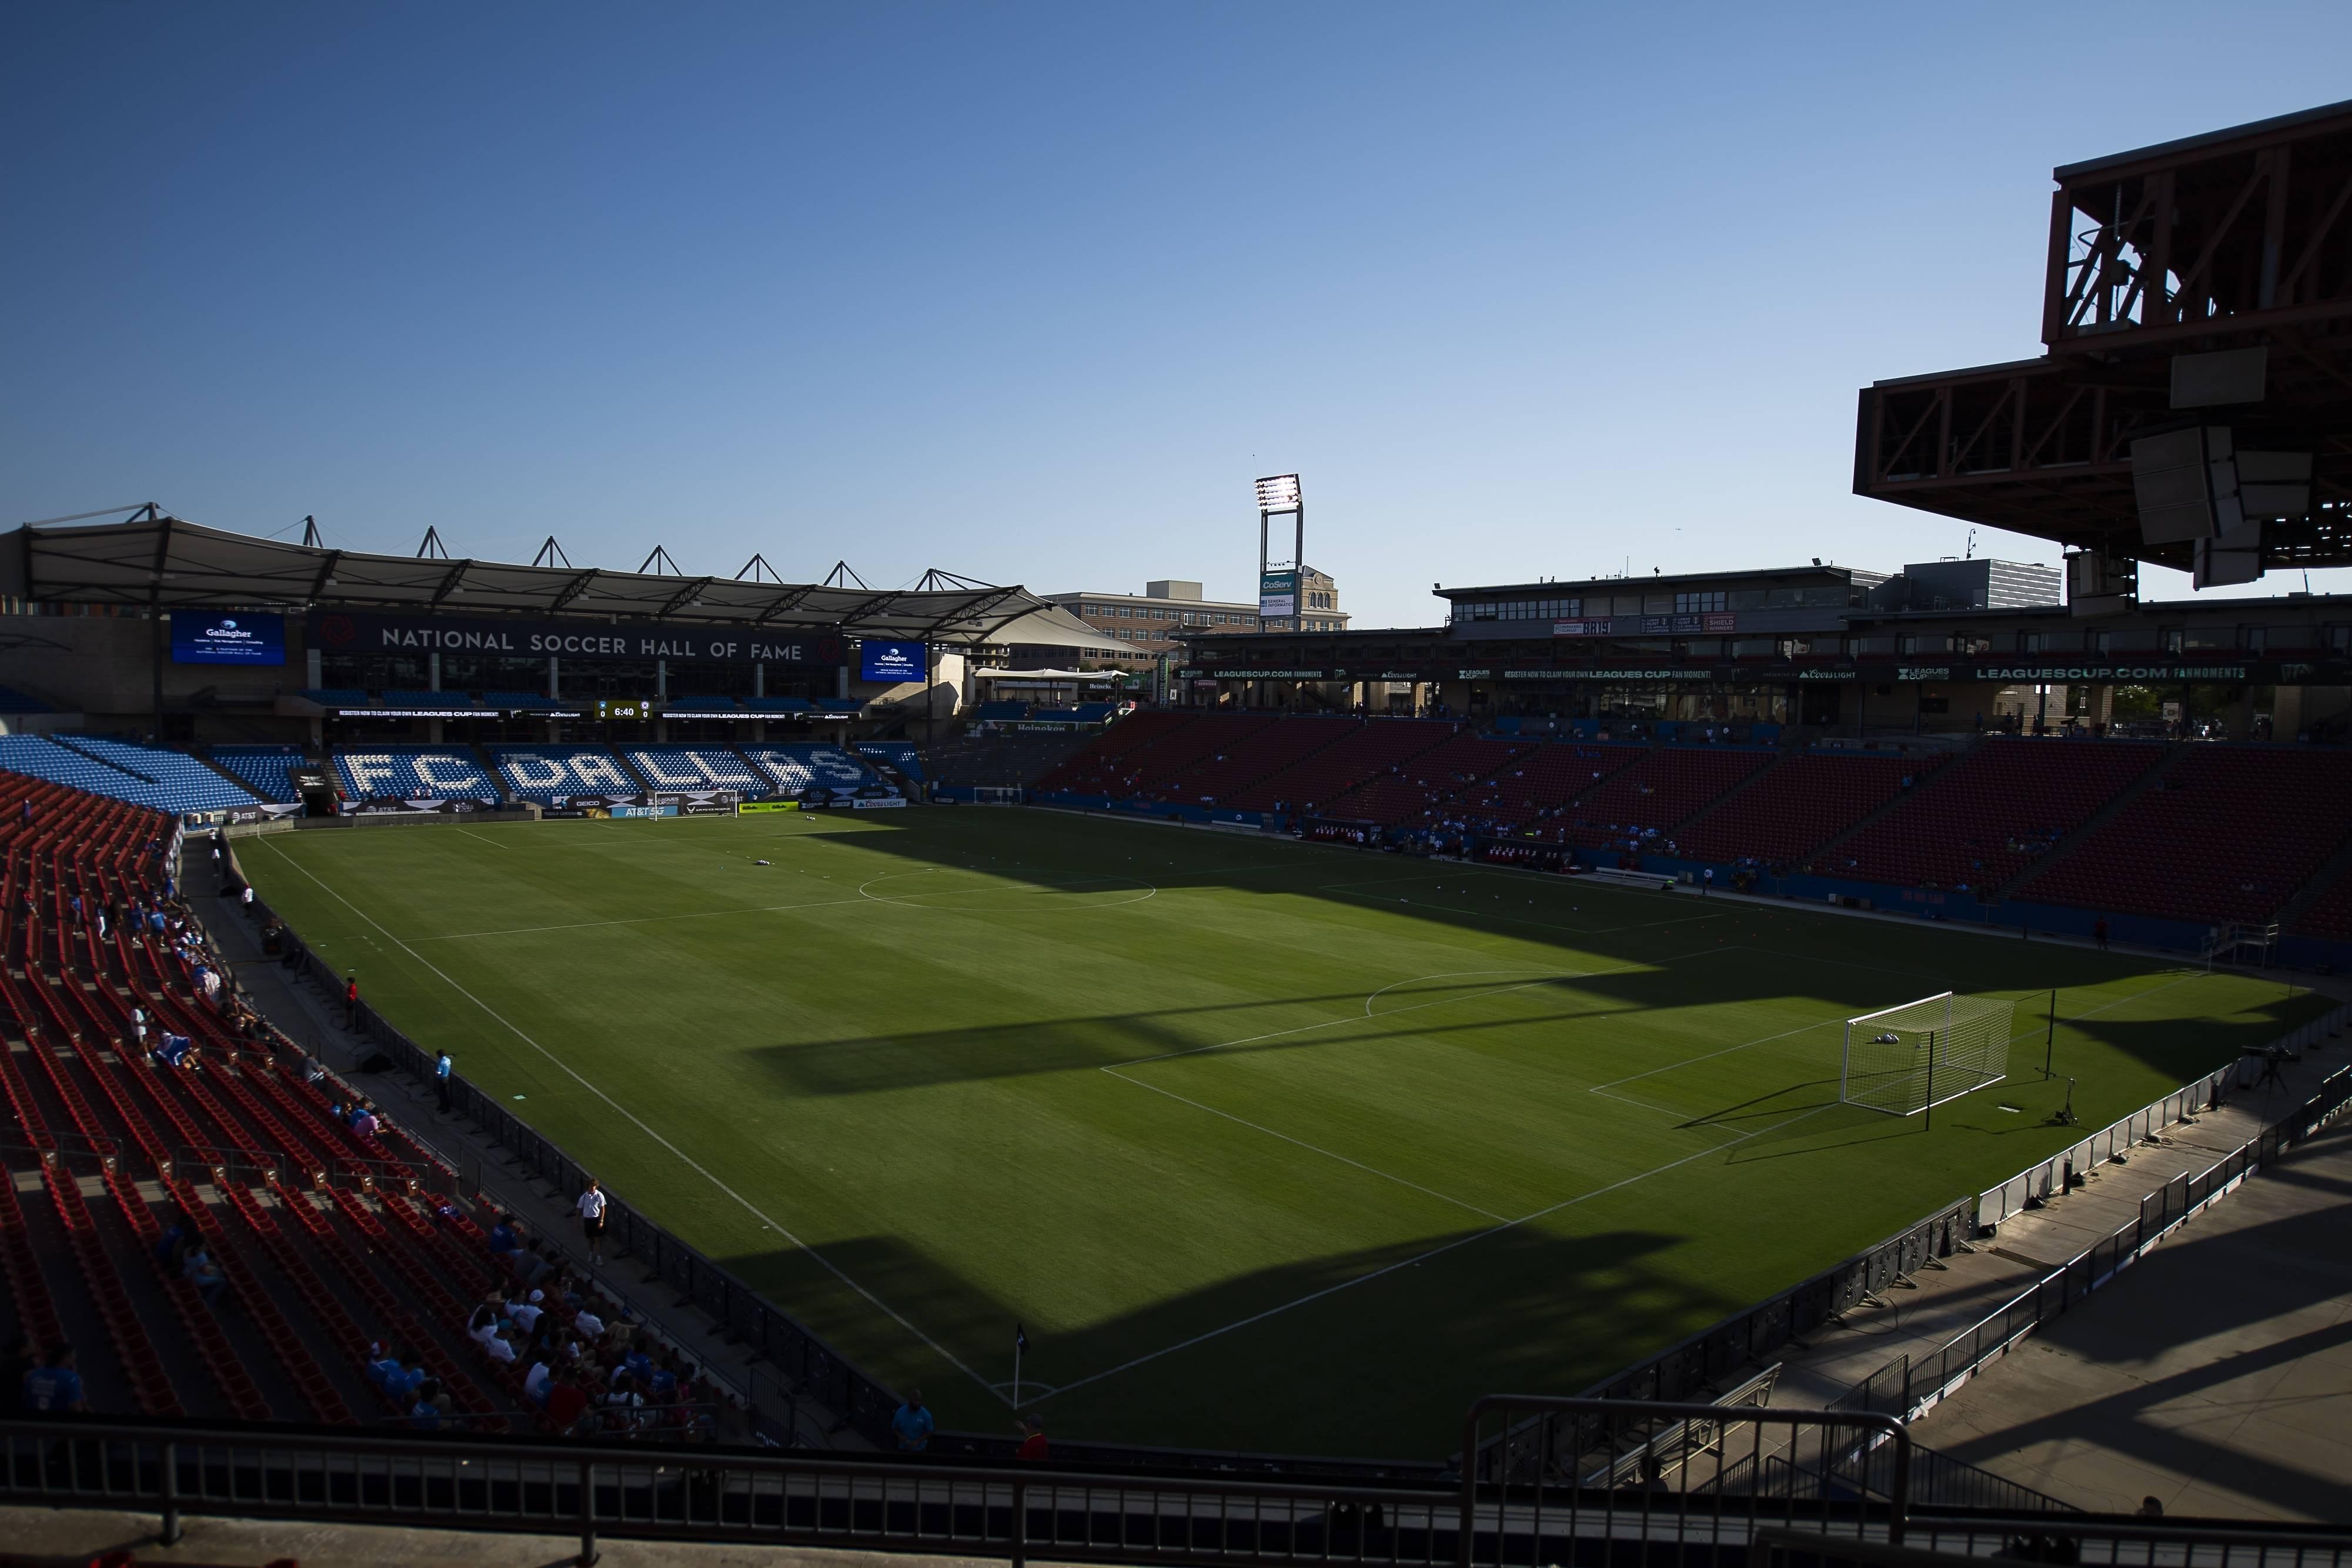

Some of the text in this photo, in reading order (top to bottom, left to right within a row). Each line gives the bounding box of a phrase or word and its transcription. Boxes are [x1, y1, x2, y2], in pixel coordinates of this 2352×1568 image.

[206, 629, 252, 638] Gallagher
[382, 628, 801, 660] NATIONAL SOCCER HALL OF FAME
[1809, 668, 1833, 679] Coors
[1976, 668, 2246, 678] LEAGUESCUP.COM/FANMOMENTS
[345, 751, 862, 792] FC DALLAS
[626, 807, 664, 816] AT&T 5G
